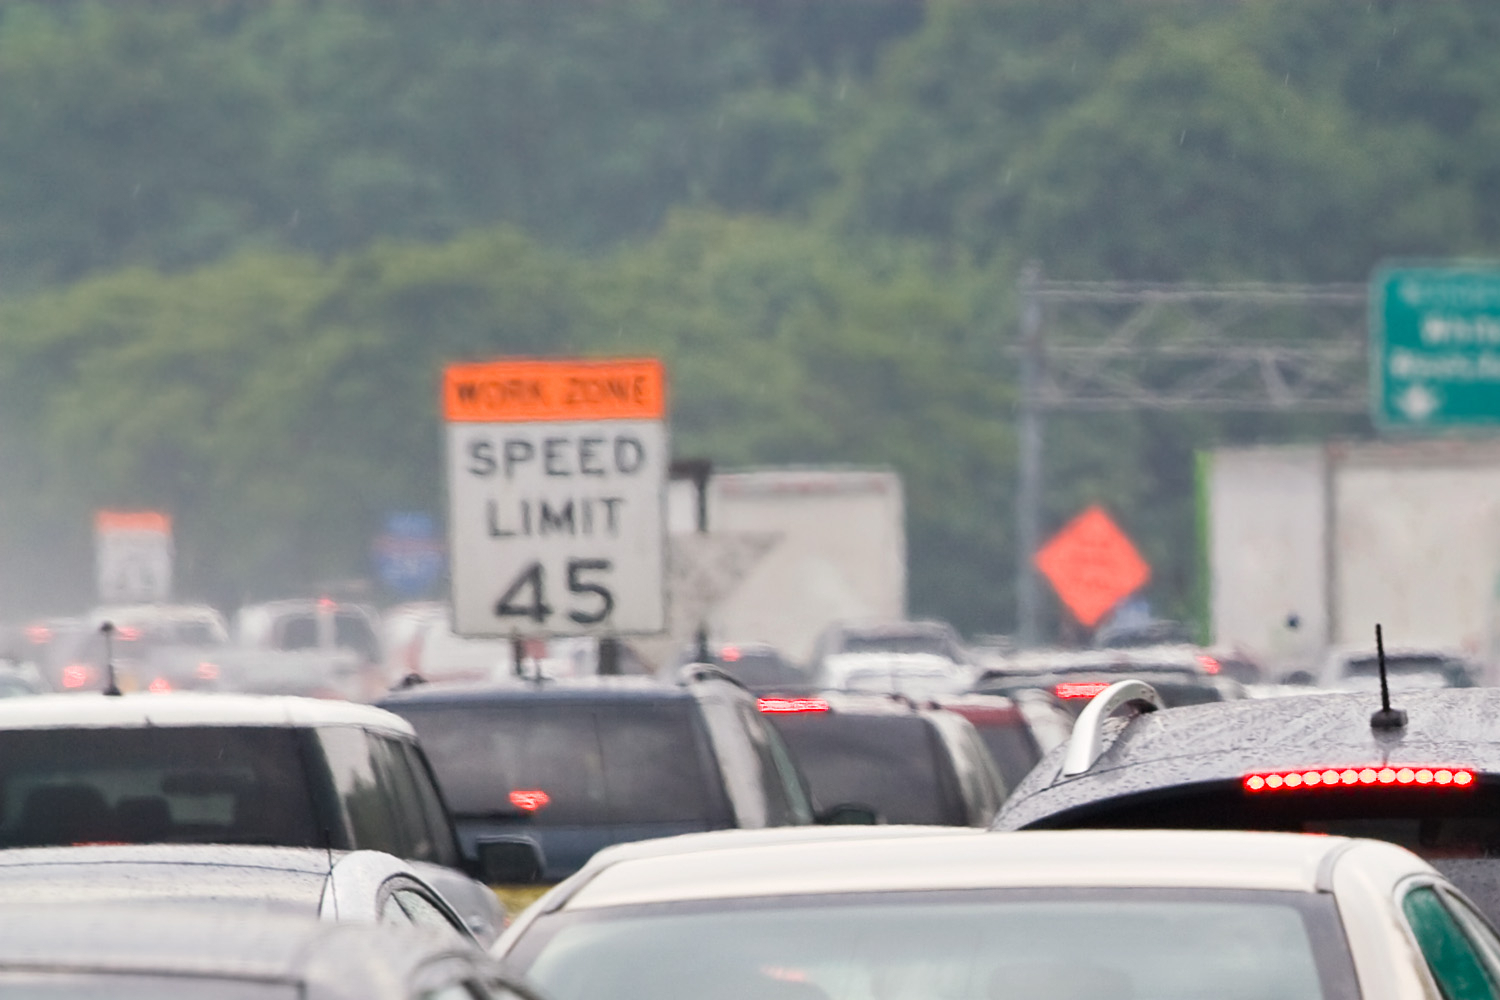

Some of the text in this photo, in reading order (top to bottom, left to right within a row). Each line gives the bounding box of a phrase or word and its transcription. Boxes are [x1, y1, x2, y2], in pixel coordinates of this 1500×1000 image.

[456, 376, 647, 405] WORK ZONE
[467, 435, 646, 478] SPEED
[487, 497, 625, 539] LIMIT
[494, 557, 615, 624] 45
